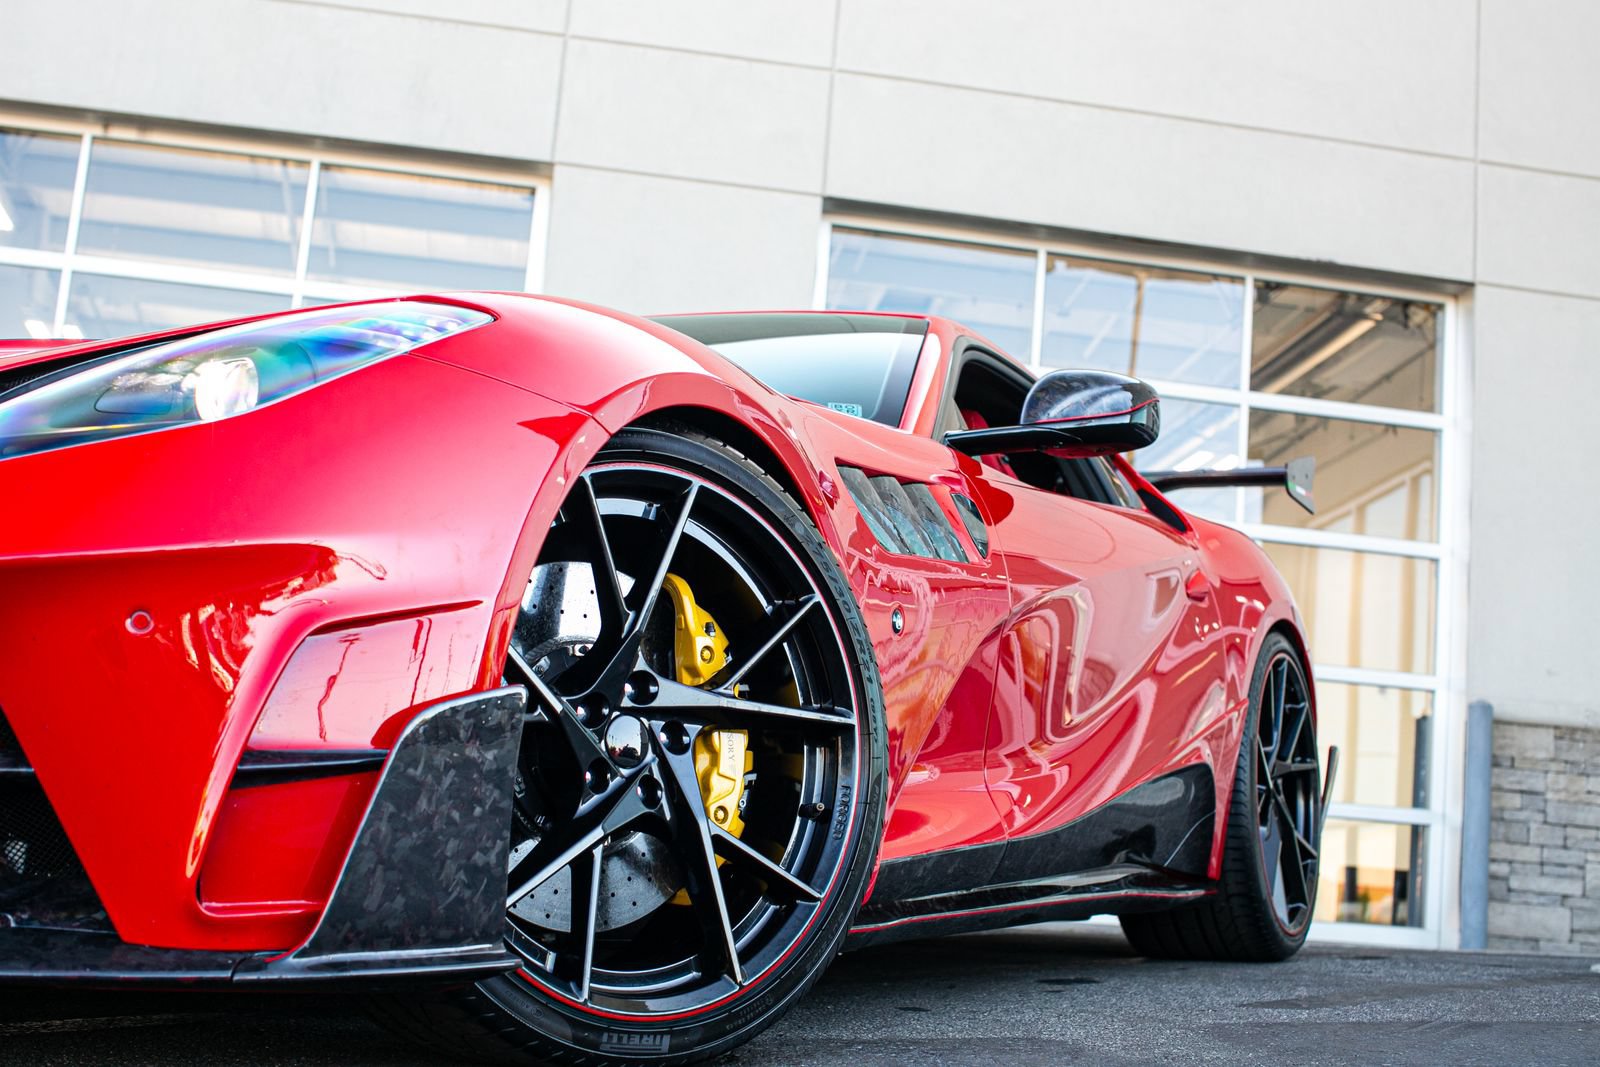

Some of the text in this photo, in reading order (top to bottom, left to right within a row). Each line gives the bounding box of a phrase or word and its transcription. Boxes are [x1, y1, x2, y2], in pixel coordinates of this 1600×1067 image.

[726, 732, 736, 761] SORY
[832, 785, 852, 841] FORGED
[600, 1032, 671, 1055] PIRELLI
